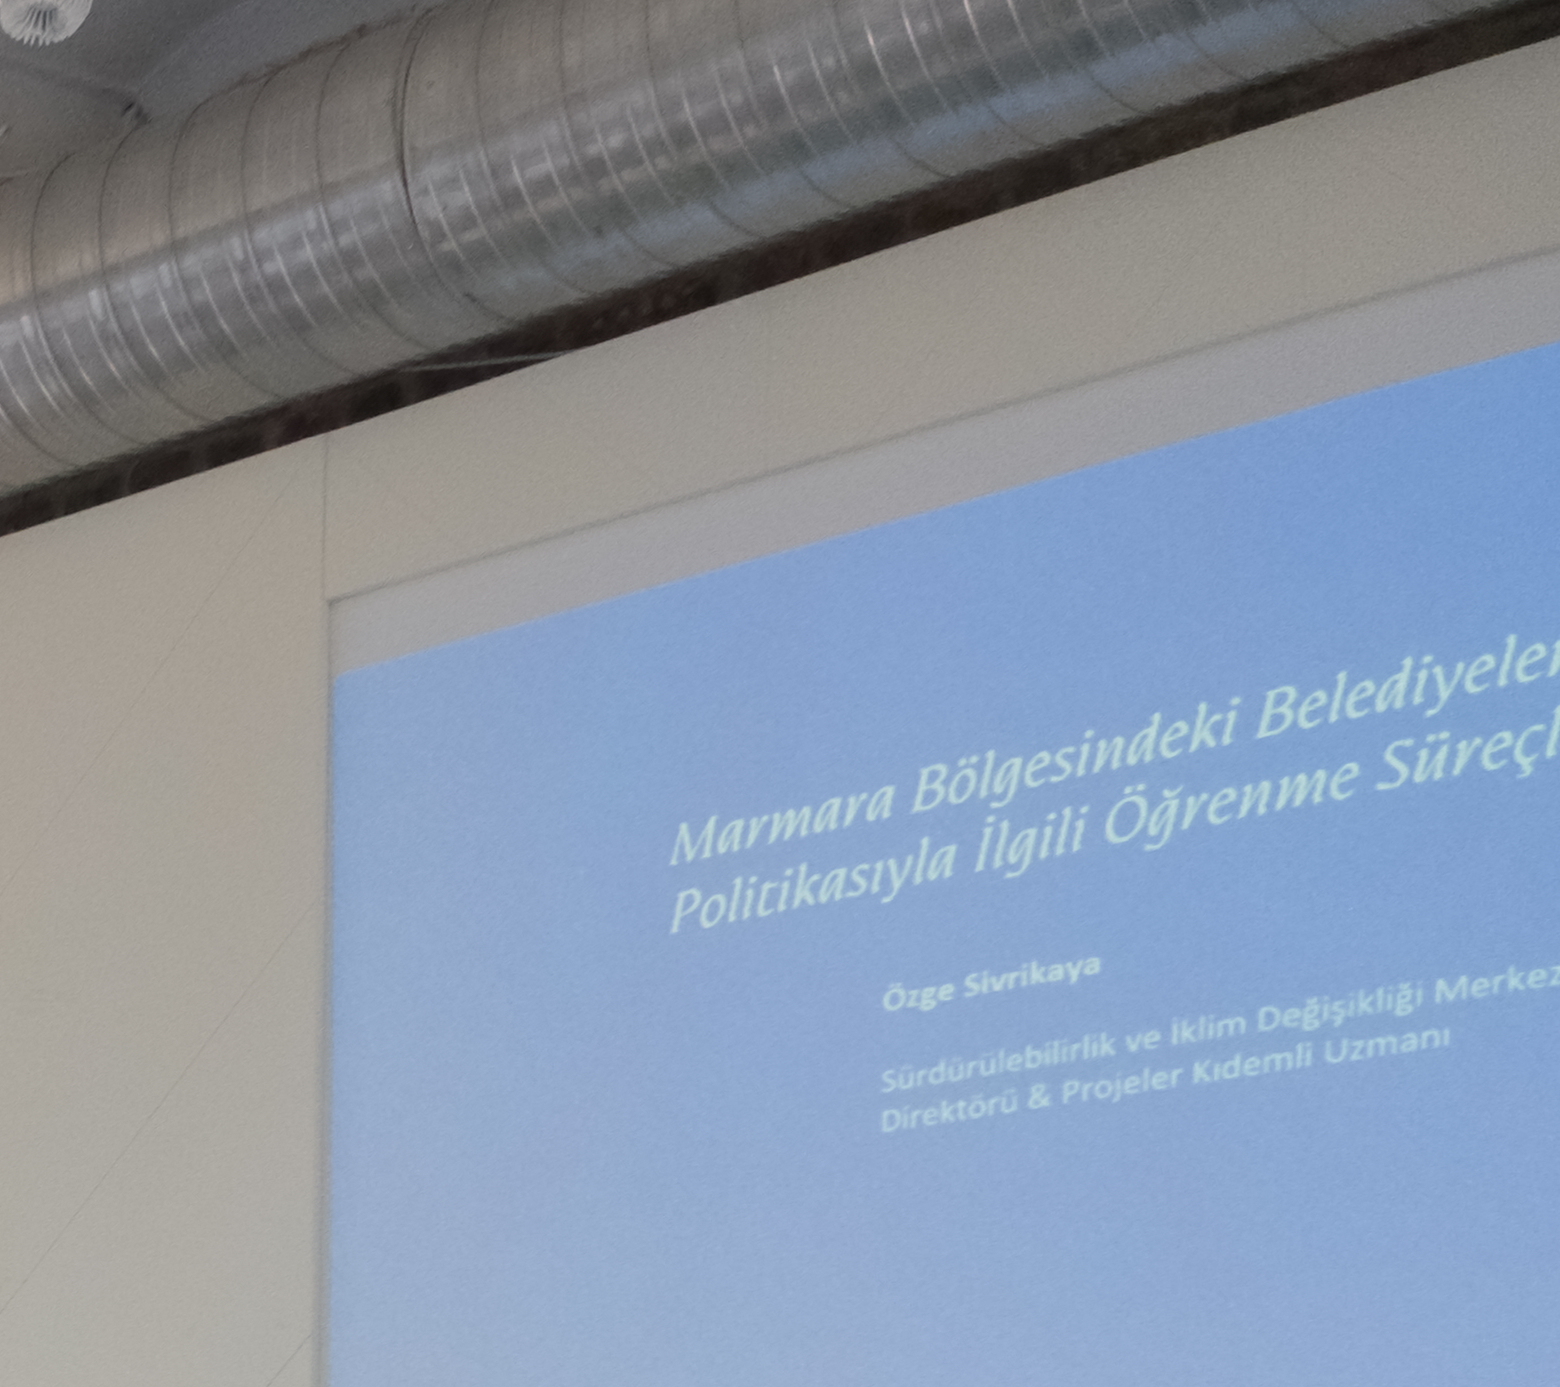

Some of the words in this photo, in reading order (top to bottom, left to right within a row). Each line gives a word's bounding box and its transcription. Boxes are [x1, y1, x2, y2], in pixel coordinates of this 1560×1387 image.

[669, 783, 896, 866] Marmara
[910, 695, 1243, 814] Bölgesindeki
[669, 836, 959, 934] Politikasıyla
[974, 804, 1091, 879] İlgili
[1104, 761, 1360, 852] Öğrenme
[881, 1031, 1117, 1093] Sürdürülebilirlik
[1125, 1028, 1162, 1052] ve
[1170, 1013, 1246, 1046] İklim
[1257, 981, 1425, 1033] Değişikliği
[882, 982, 955, 1011] Özge
[964, 956, 1101, 999] Sivrikaya
[881, 1086, 1019, 1134] Direktörü
[1028, 1084, 1053, 1110] &
[1062, 1068, 1185, 1103] Projeler
[1192, 1041, 1314, 1085] Kıdemli
[1325, 1028, 1452, 1065] Uzmanı
